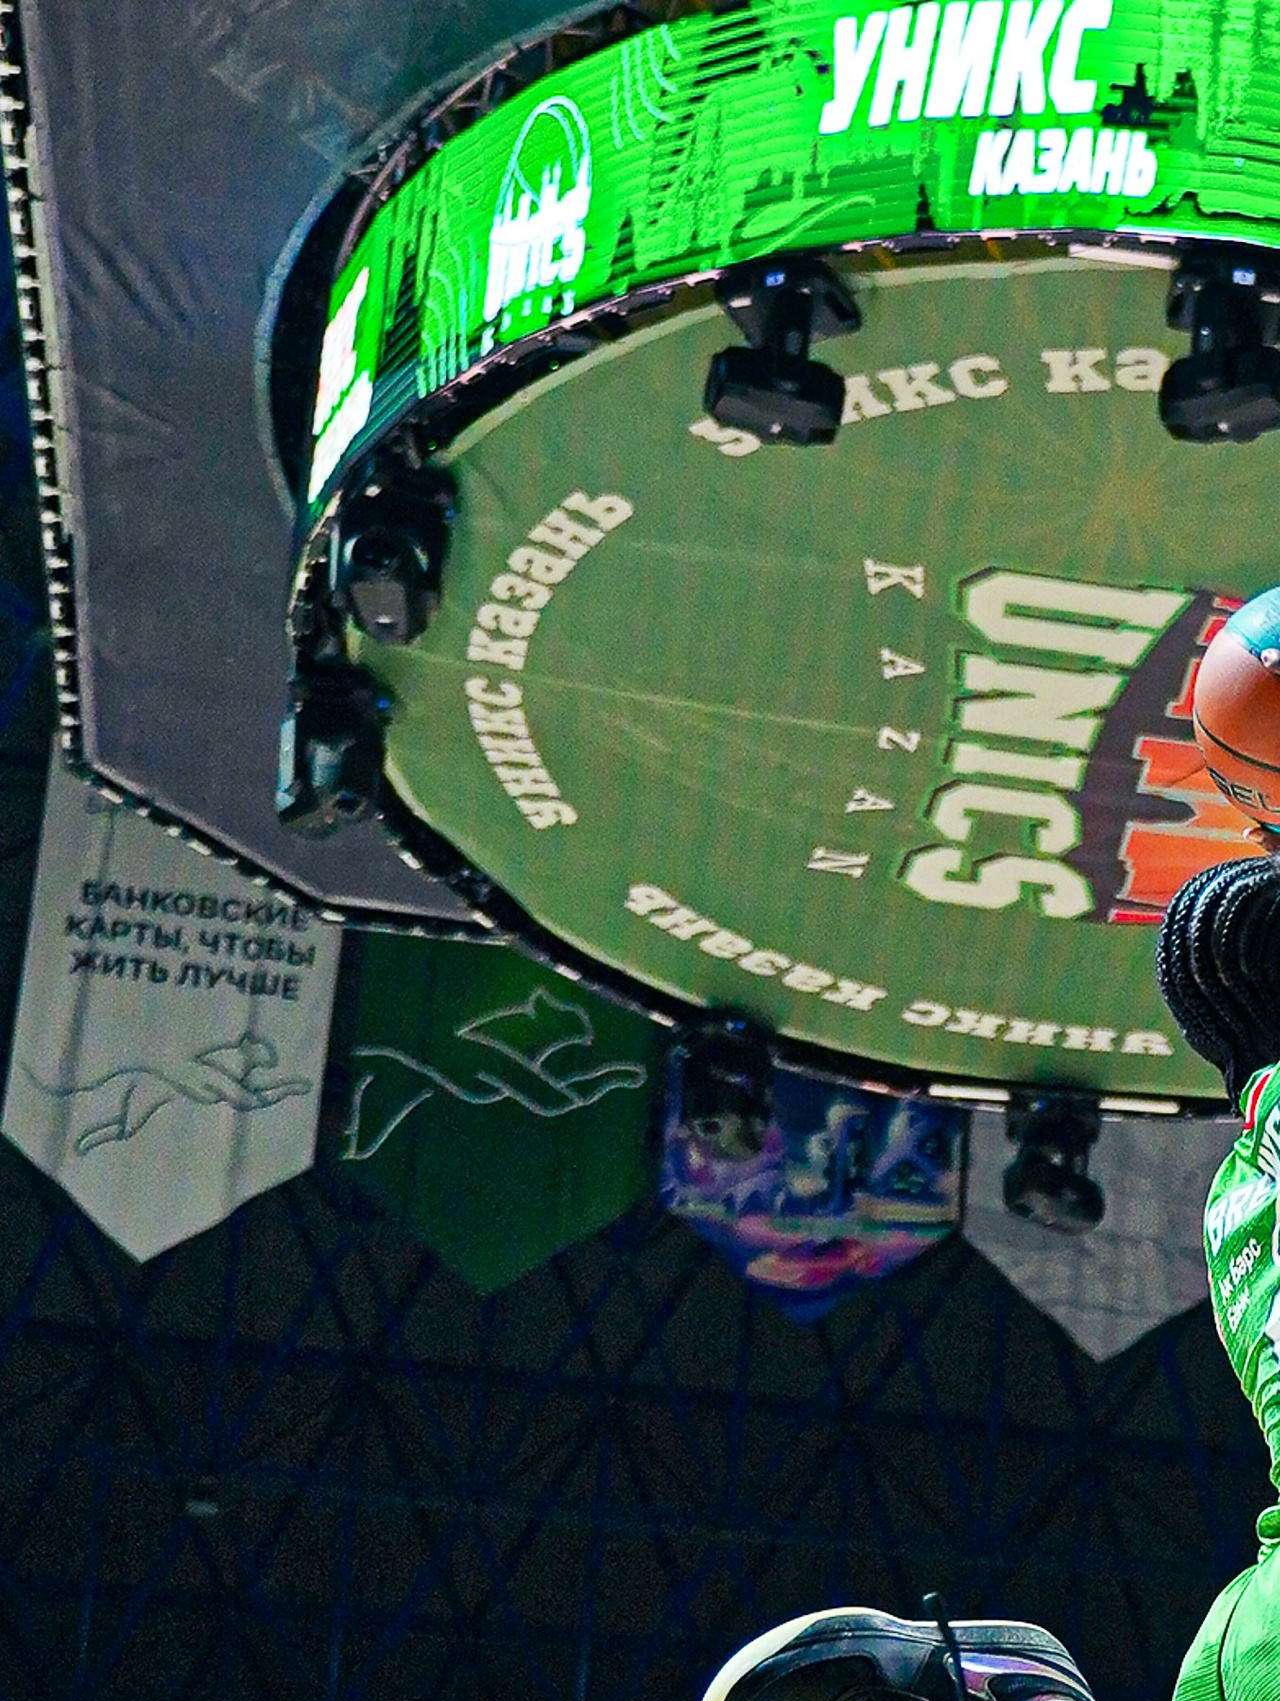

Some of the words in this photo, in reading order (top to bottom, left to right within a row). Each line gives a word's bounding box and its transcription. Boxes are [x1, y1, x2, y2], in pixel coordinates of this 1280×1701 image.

[819, 0, 1111, 134] УНИКС
[968, 129, 1158, 198] КАЗАНЬ
[897, 566, 1195, 921] UNICS
[69, 951, 170, 984] ЖИТЬ
[176, 962, 301, 1001] ЛУЧШЕ
[200, 930, 317, 967] ЧТОБЫ
